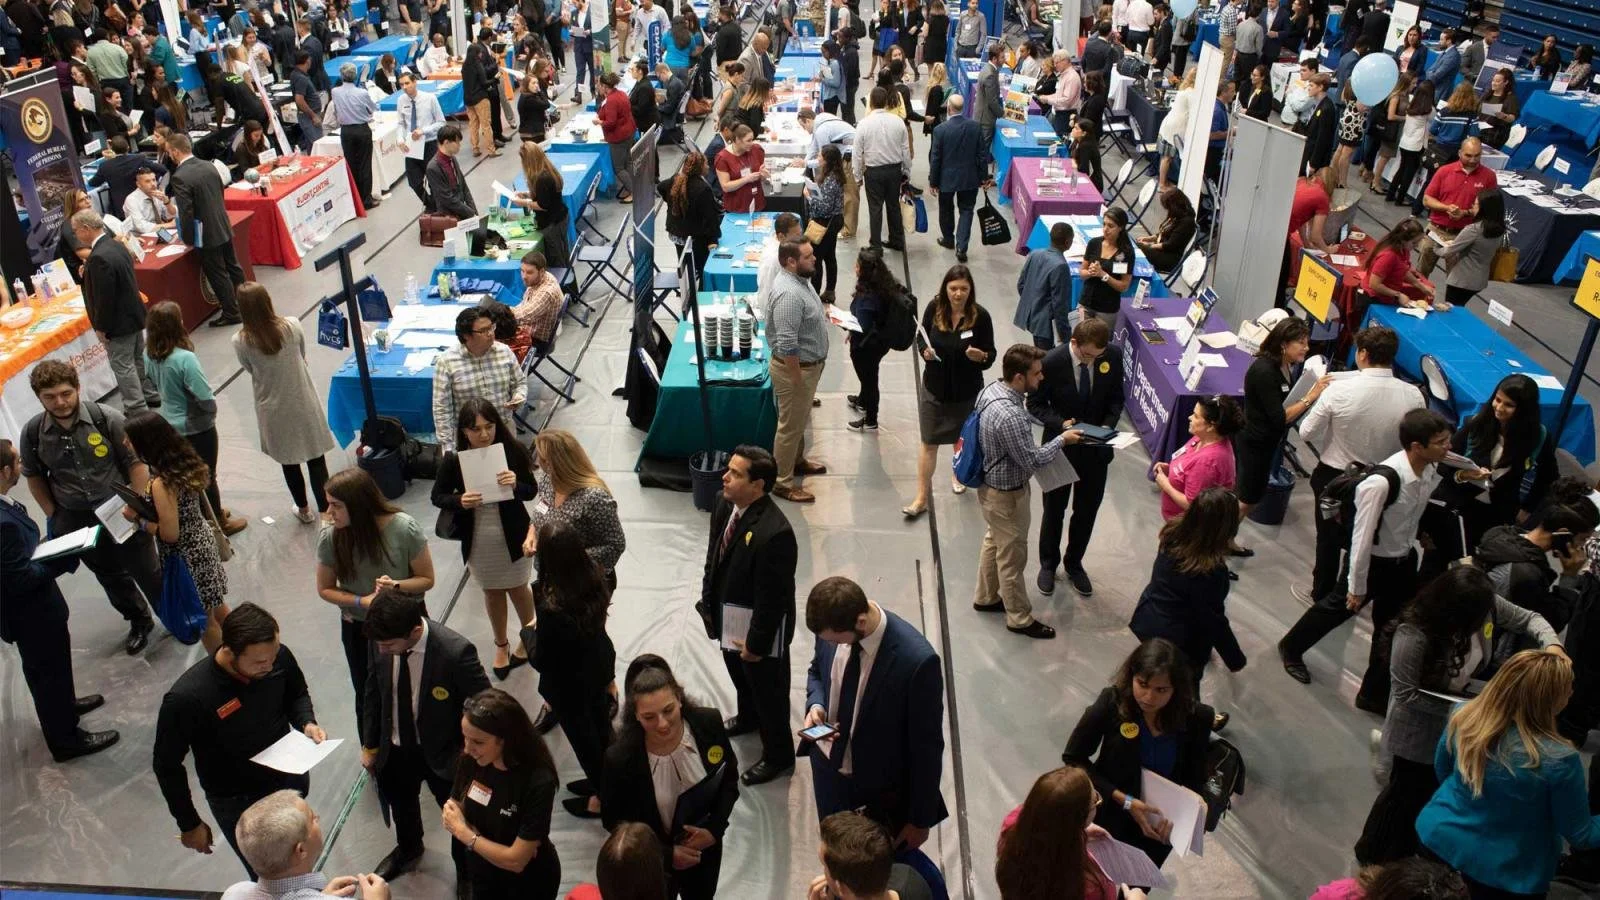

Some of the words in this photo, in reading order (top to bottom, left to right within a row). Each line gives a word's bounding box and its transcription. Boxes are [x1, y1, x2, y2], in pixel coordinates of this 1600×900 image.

[27, 150, 47, 166] FEDERAL
[47, 144, 68, 157] BUREAU
[35, 159, 42, 168] OF
[41, 153, 63, 165] PRISONS
[1133, 384, 1141, 401] of
[1140, 393, 1158, 433] Health
[1137, 362, 1169, 424] Department
